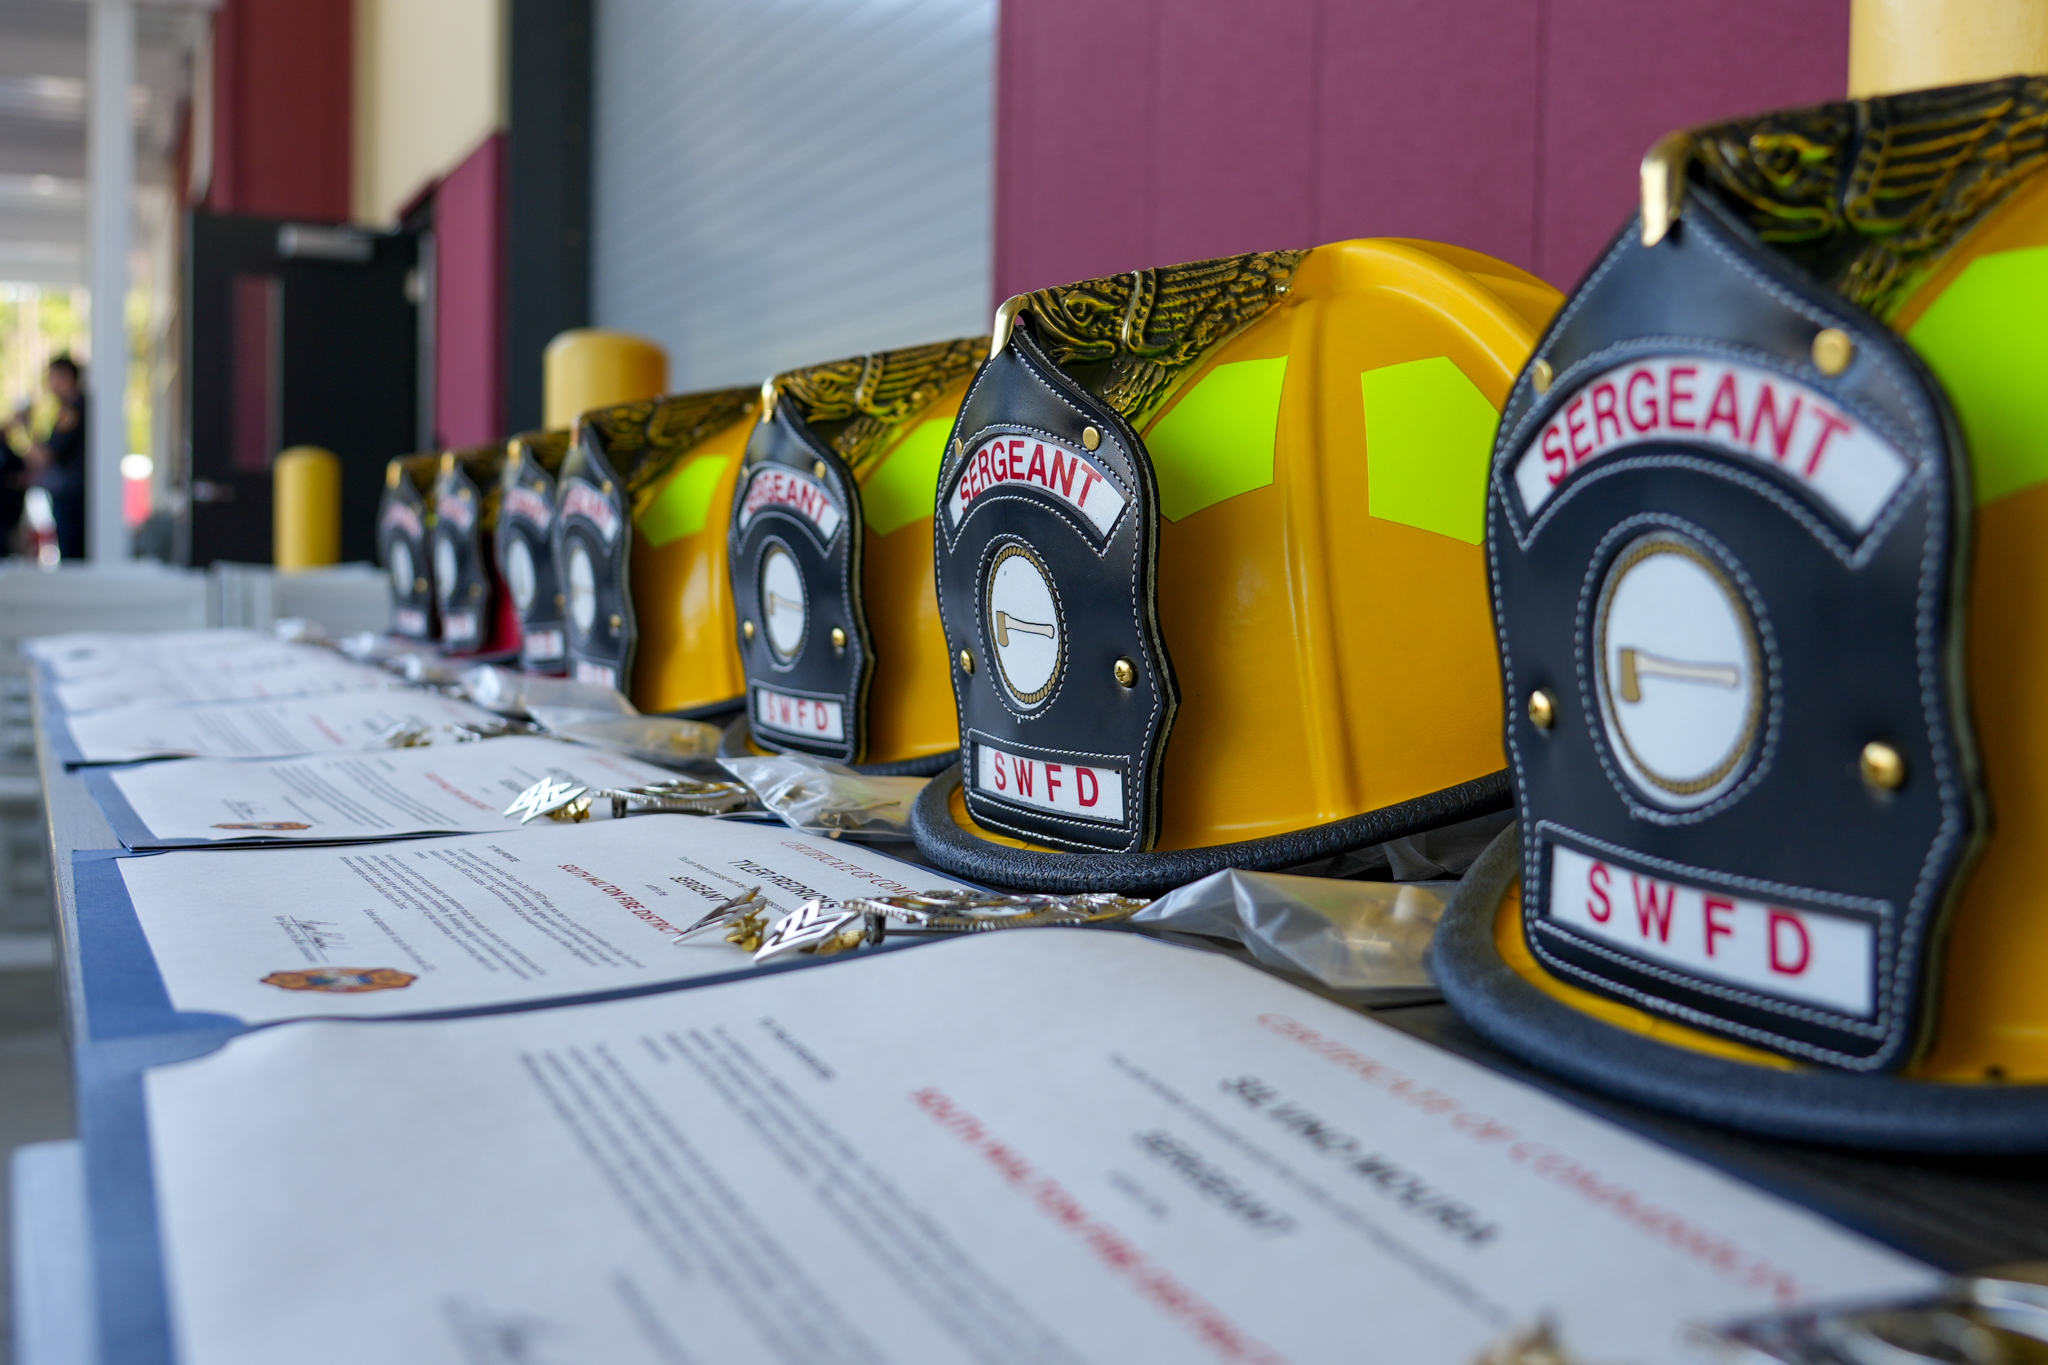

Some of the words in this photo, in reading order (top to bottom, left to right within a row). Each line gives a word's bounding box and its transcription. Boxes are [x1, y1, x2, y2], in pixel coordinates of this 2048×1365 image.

[1541, 366, 1855, 488] SERGEANT
[960, 440, 1103, 513] SERGEANT
[669, 876, 732, 902] SERGEANT
[728, 859, 776, 877] TYLER
